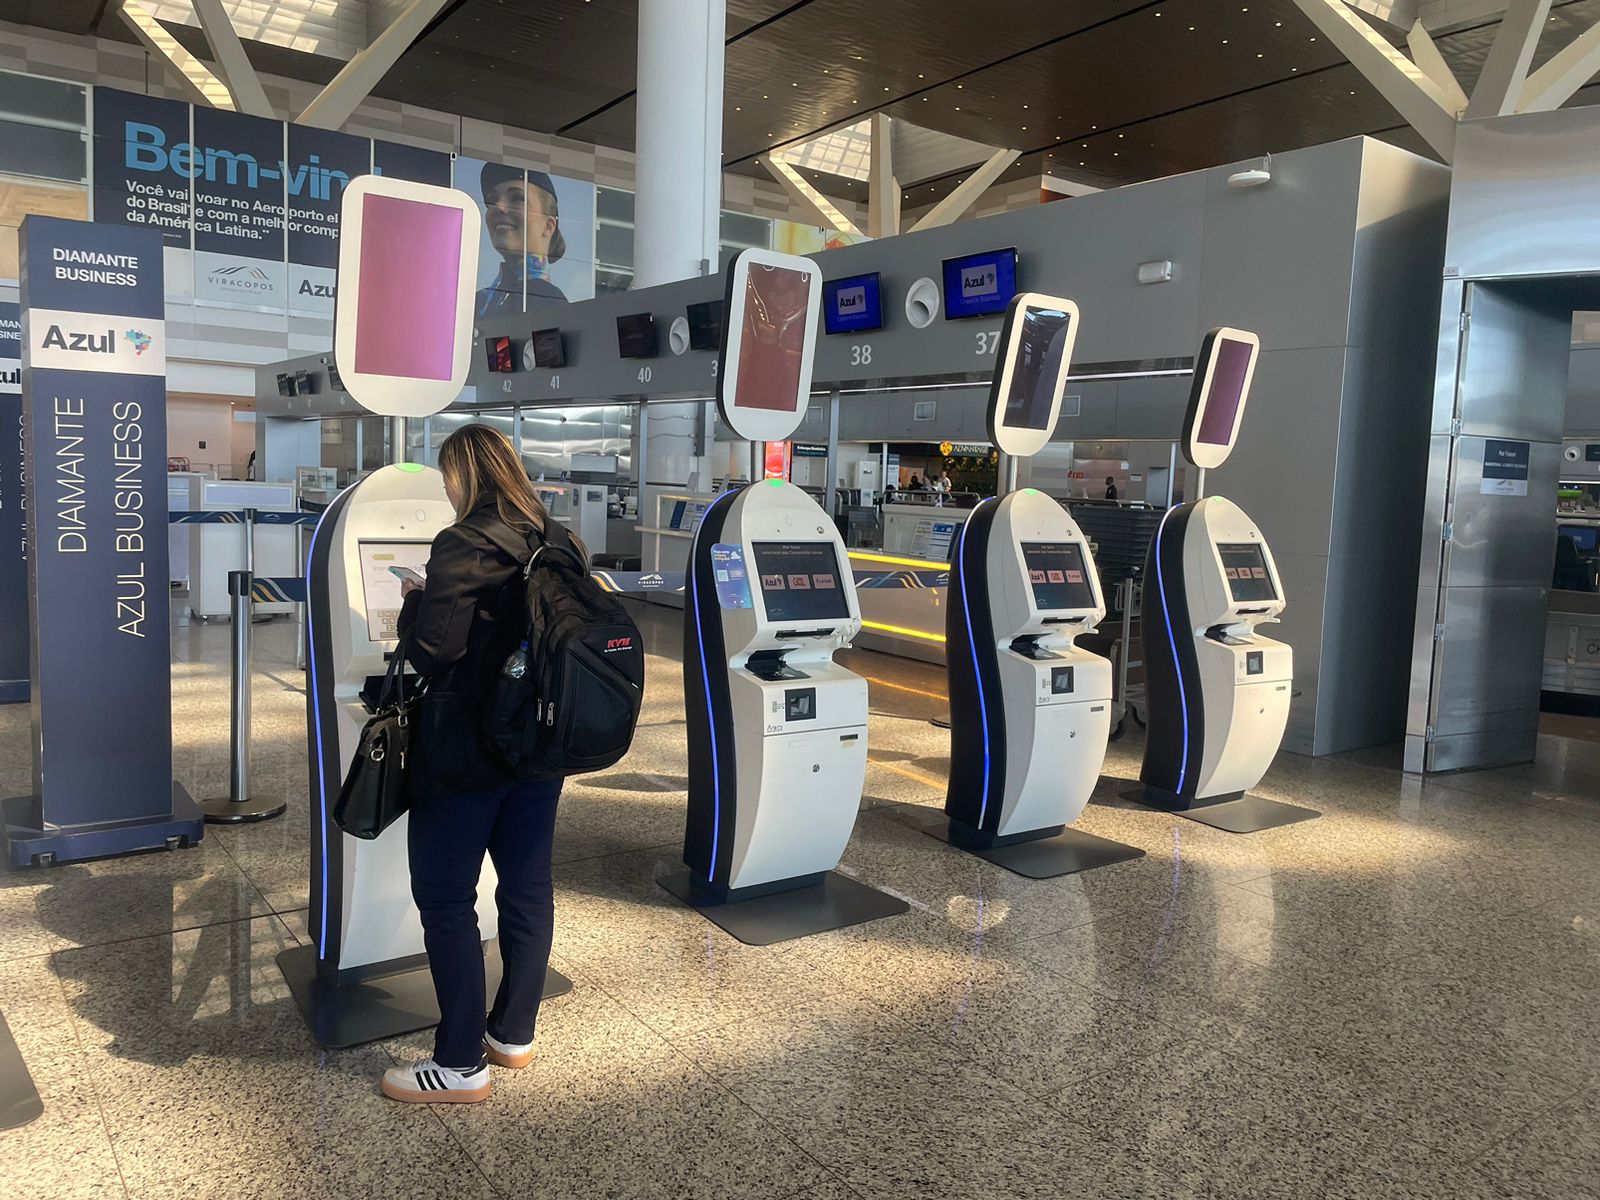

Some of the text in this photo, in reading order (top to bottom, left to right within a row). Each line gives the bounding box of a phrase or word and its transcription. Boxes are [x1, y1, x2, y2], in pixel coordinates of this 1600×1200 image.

[125, 120, 382, 201] Bem-vin
[126, 180, 338, 223] Você vai voar no Aeroporto el
[126, 196, 146, 208] do
[195, 208, 204, 217] e
[207, 210, 238, 222] com
[241, 215, 250, 224] a
[252, 215, 302, 231] melhor
[304, 224, 338, 239] comp
[126, 210, 145, 223] da
[148, 212, 211, 232] América
[53, 248, 138, 269] DIAMANTE
[56, 267, 137, 286] BUSINESS
[208, 277, 274, 291] VIRACOPOS
[964, 275, 984, 289] Azul
[840, 295, 856, 307] Azul
[42, 325, 115, 353] Azul
[975, 331, 1000, 355] 37
[851, 345, 872, 365] 38
[638, 367, 652, 383] 40
[711, 360, 718, 377] 3
[502, 380, 512, 393] 42
[550, 375, 560, 389] 41
[54, 397, 87, 552] DIAMANTE
[113, 402, 145, 637] AZUL BUSINESS
